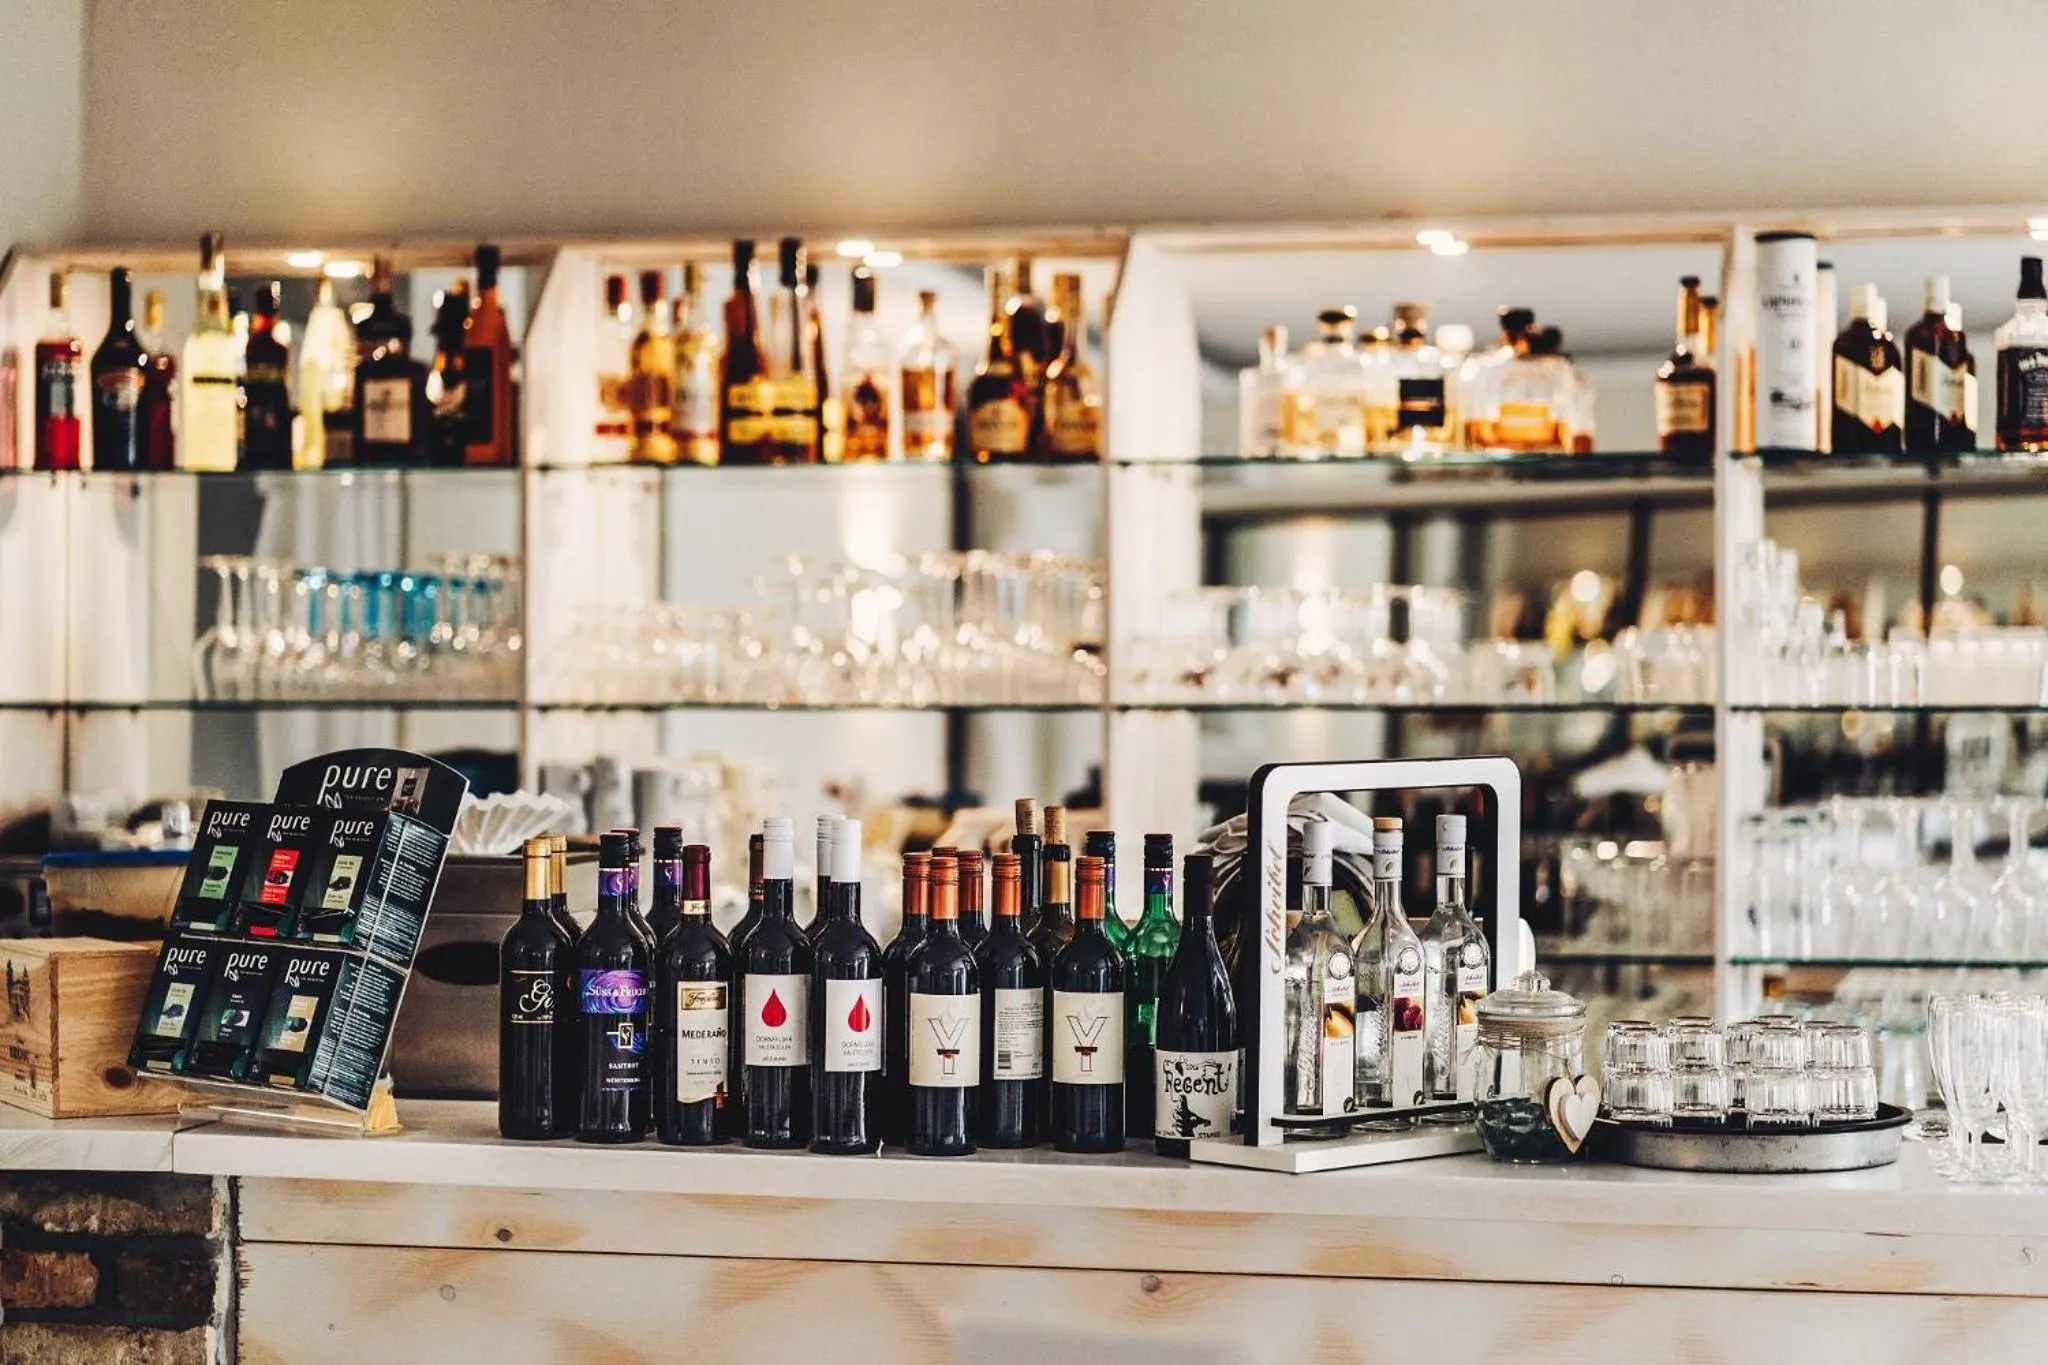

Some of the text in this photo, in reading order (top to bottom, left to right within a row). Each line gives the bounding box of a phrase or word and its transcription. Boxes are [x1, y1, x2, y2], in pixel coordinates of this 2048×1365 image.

[317, 765, 392, 805] pure
[207, 810, 250, 835] pure
[267, 814, 311, 839] pure
[329, 819, 374, 844] pure
[163, 947, 207, 972] pure
[224, 953, 269, 977] pure
[284, 958, 330, 983] pure
[681, 1027, 727, 1039] MEDERAÑO
